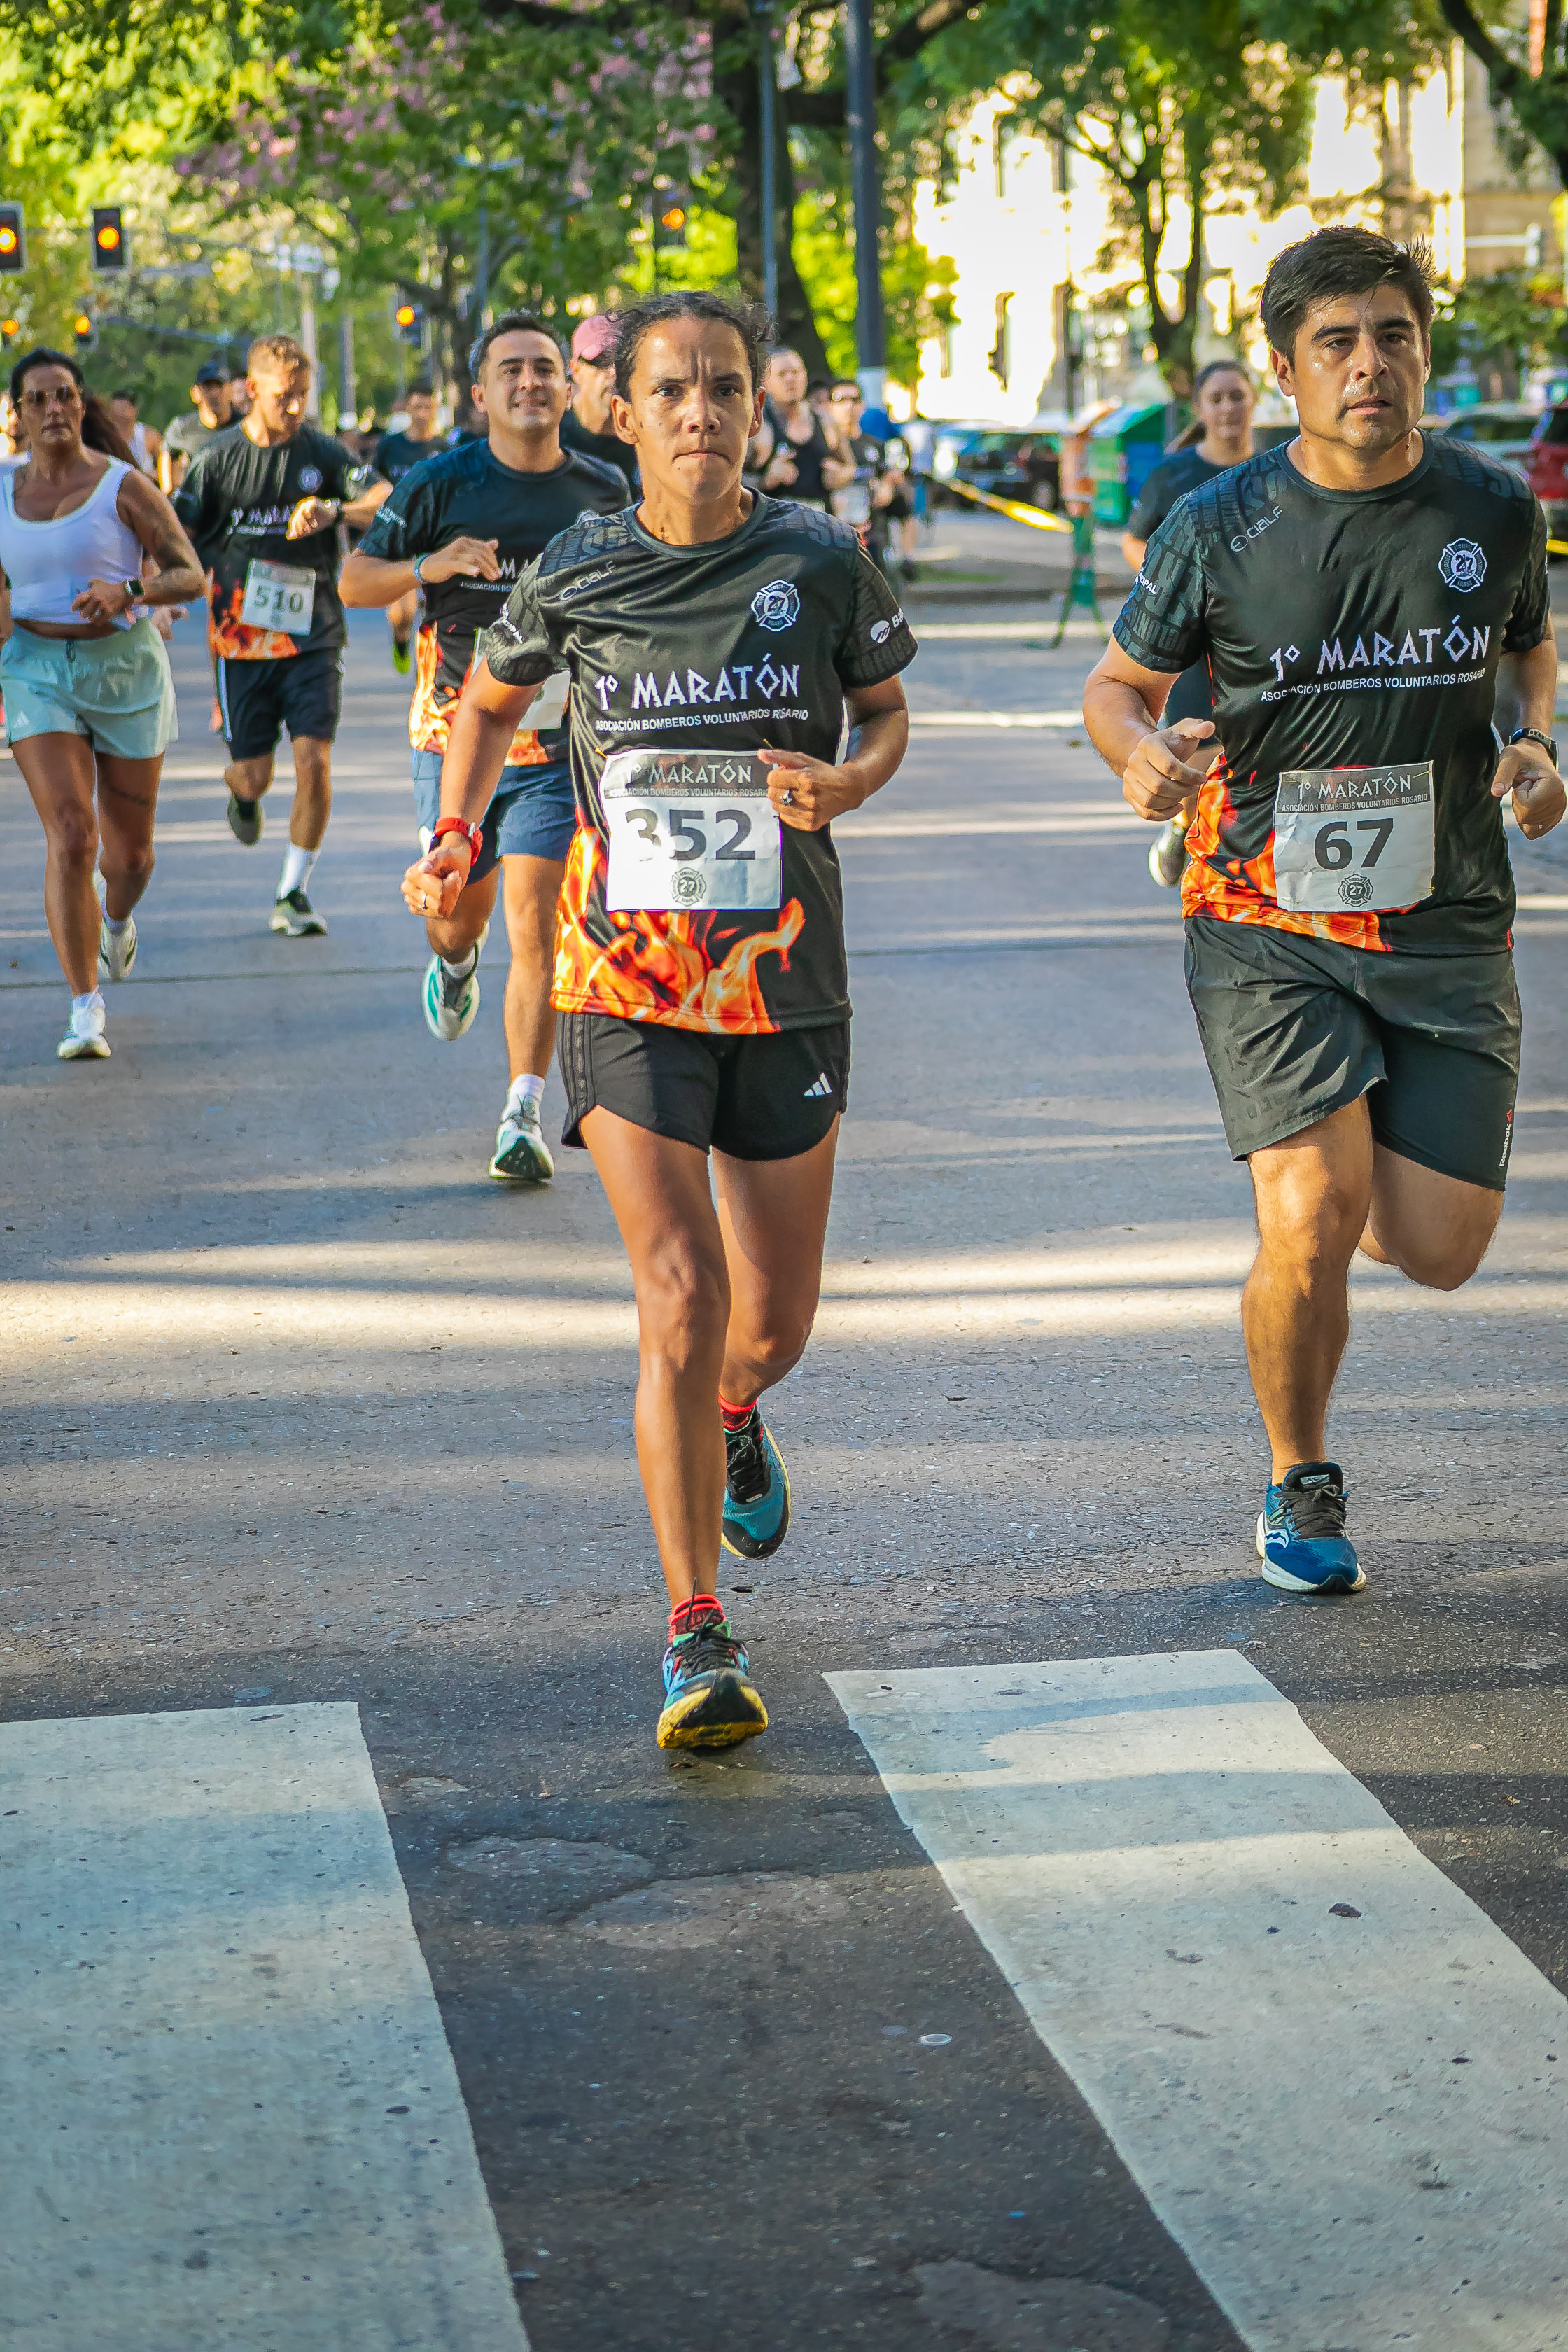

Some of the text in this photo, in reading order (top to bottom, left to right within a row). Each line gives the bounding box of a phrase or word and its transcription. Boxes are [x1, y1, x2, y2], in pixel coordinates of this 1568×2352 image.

[1456, 554, 1474, 573] 27
[253, 585, 304, 613] 510
[767, 595, 785, 612] 27
[1316, 615, 1490, 676] MARATÓN
[631, 652, 800, 710] MARATÓN
[1324, 678, 1382, 691] BOMBEROS
[1385, 673, 1456, 688] VOLUNTARIOS
[595, 718, 640, 732] ASOCIACIÓN
[642, 715, 701, 730] BOMBEROS
[702, 708, 770, 724] VOLUNTARIOS
[649, 759, 752, 784] MARATÓN
[650, 788, 690, 797] BOMBEROS
[690, 788, 738, 797] VOLUNTARIOS
[1318, 771, 1411, 799] MARATÓN
[1282, 793, 1428, 812] ASOCIACIÓN BOMBEROS VOLUNTARIOS ROSARIO
[624, 808, 755, 862] 352
[1314, 818, 1394, 870] 67
[678, 878, 696, 897] 27
[1350, 885, 1364, 896] 27
[1499, 1123, 1512, 1167] Reebok
